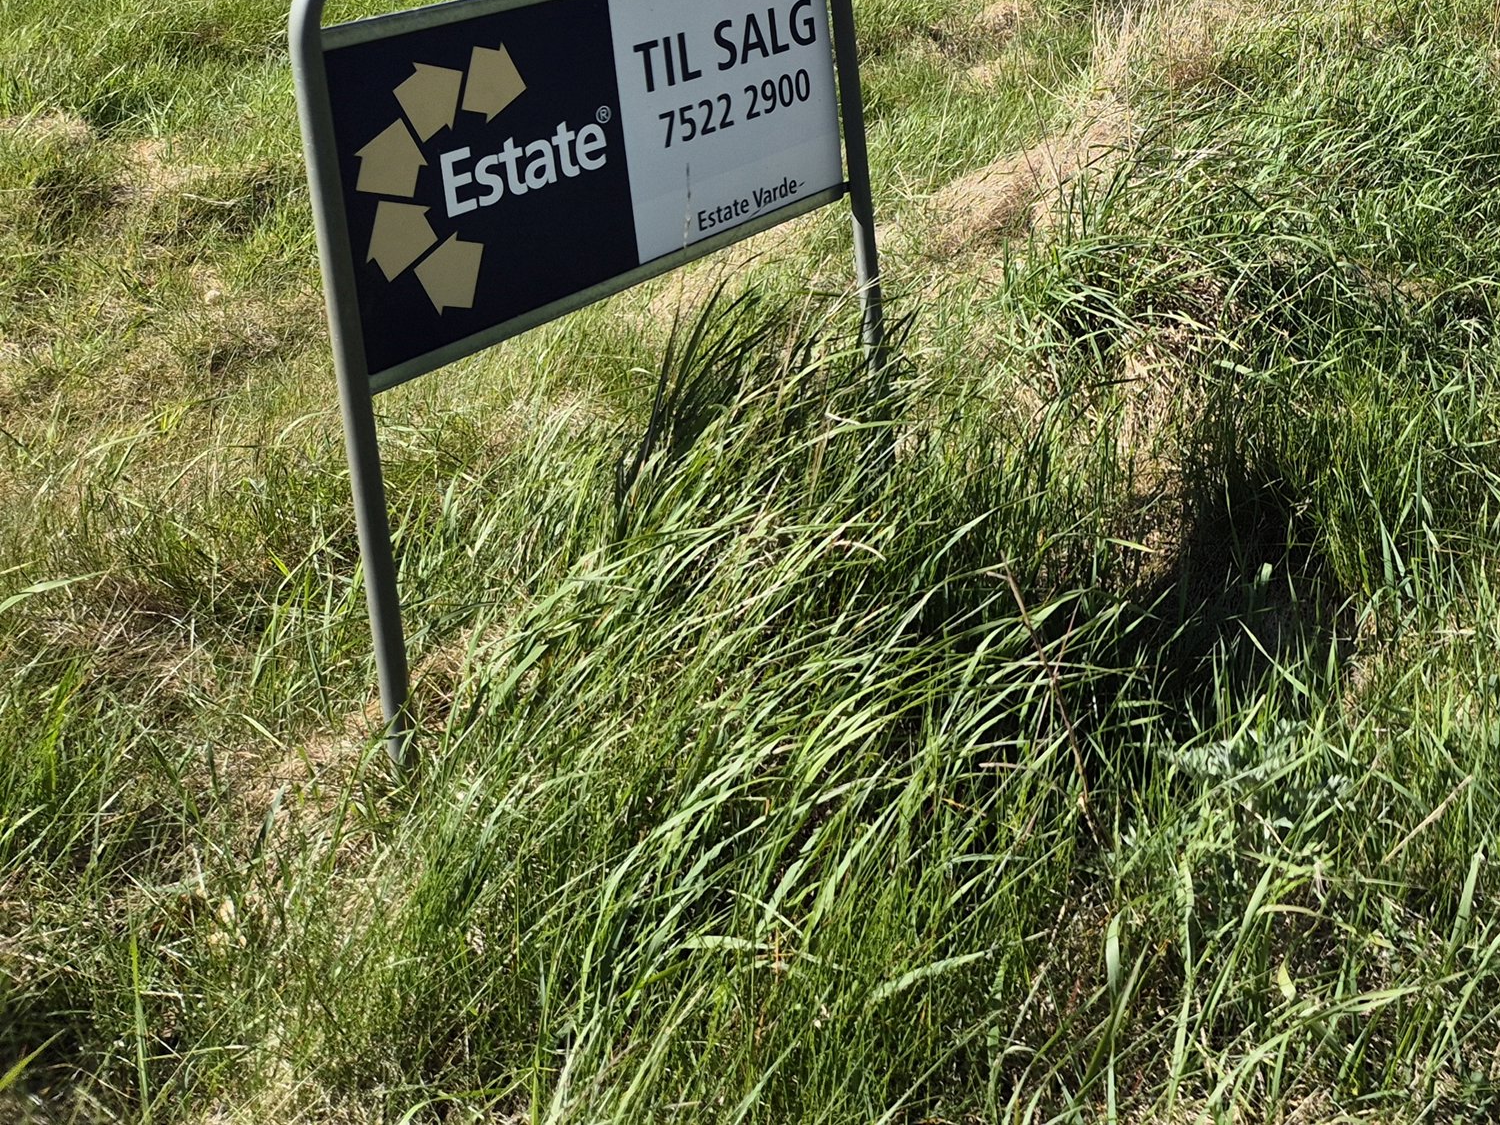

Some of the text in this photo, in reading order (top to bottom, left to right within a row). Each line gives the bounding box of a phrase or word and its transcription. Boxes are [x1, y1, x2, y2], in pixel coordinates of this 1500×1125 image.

[633, 32, 702, 93] TIL
[658, 68, 811, 149] 7522 2900
[697, 198, 749, 232] Estate
